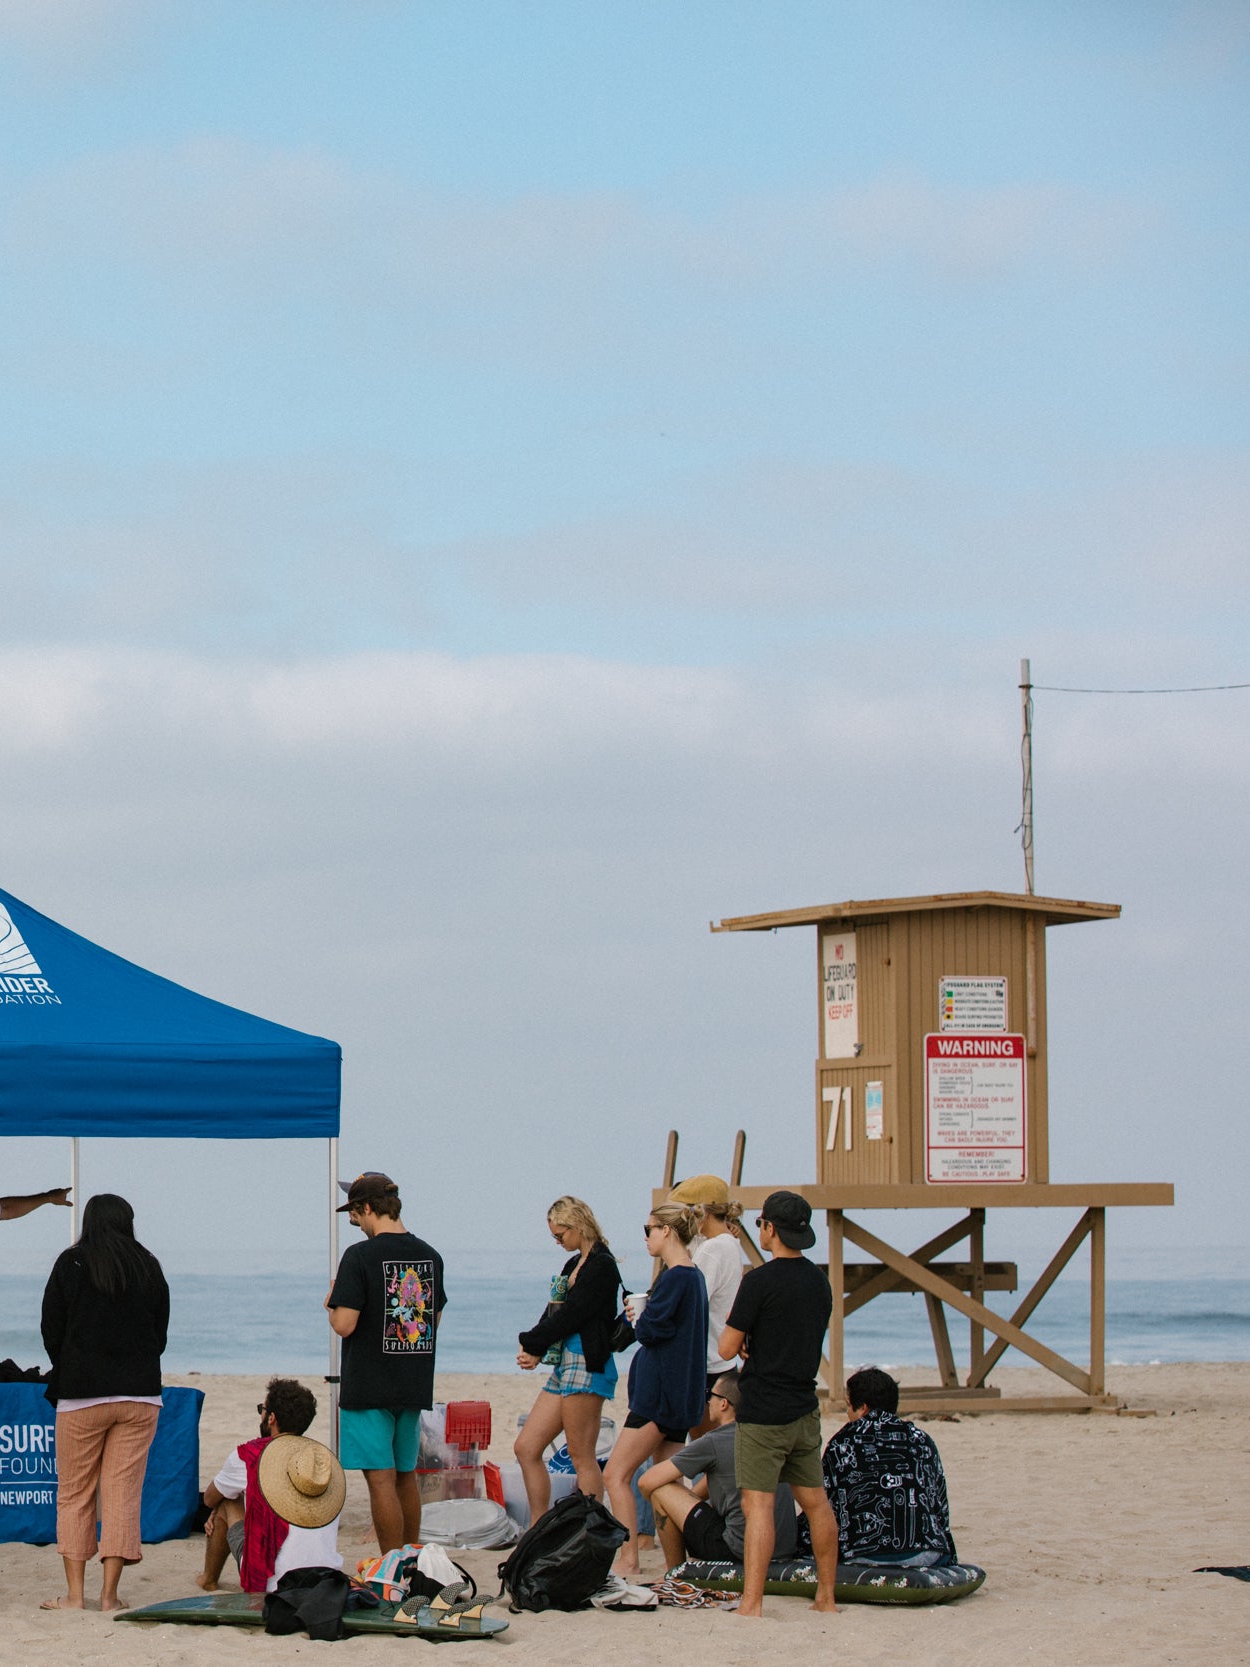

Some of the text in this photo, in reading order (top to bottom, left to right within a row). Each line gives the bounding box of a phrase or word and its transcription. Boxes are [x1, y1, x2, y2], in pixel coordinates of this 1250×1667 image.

[826, 984, 854, 1002] ON DUTY
[828, 1003, 853, 1020] KEEP OFF
[937, 1040, 1014, 1056] WARNING
[822, 1086, 852, 1150] 71
[0, 1490, 53, 1505] NEWPORT
